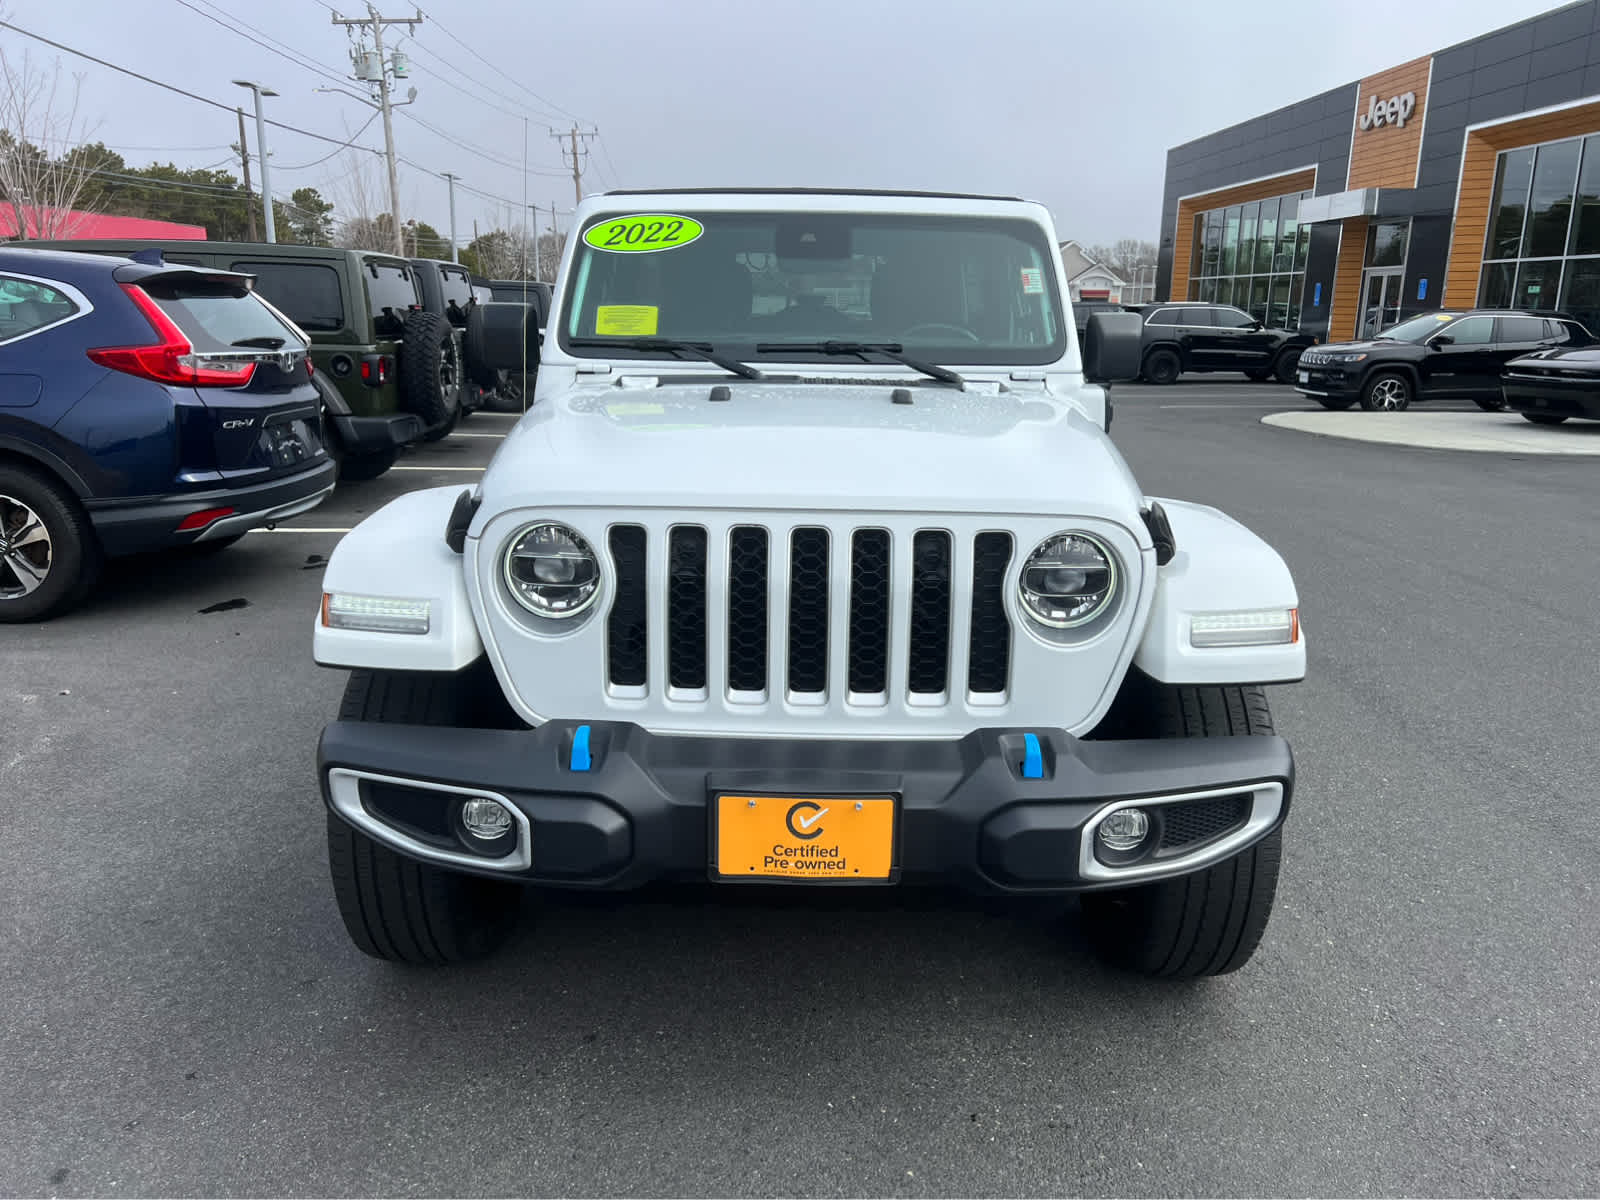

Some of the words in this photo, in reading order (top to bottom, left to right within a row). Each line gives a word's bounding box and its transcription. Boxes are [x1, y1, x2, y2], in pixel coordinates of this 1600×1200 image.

[1360, 91, 1416, 131] Jeep
[603, 220, 684, 246] 2022
[222, 418, 255, 429] CR-V
[772, 844, 839, 858] Certified
